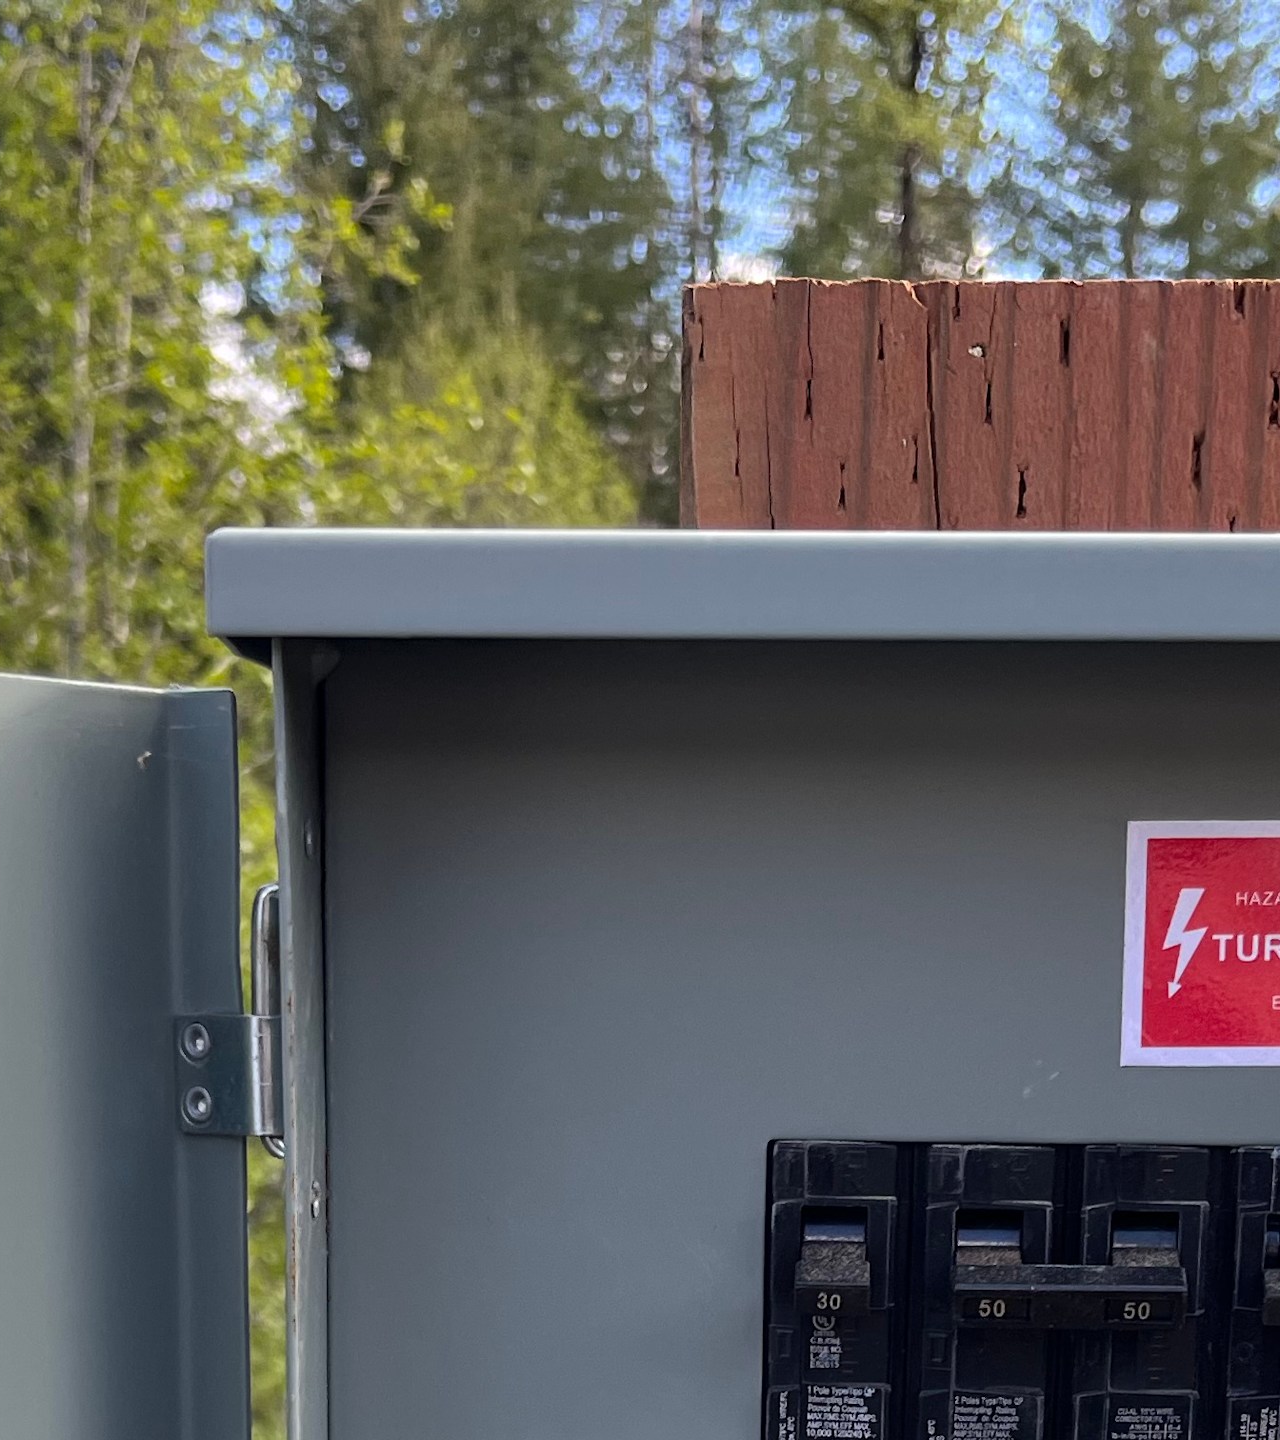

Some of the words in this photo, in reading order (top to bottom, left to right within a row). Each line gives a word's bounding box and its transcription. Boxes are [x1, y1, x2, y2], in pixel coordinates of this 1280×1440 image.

[816, 1291, 841, 1311] 30
[978, 1299, 1006, 1318] 50
[1123, 1302, 1151, 1320] 50
